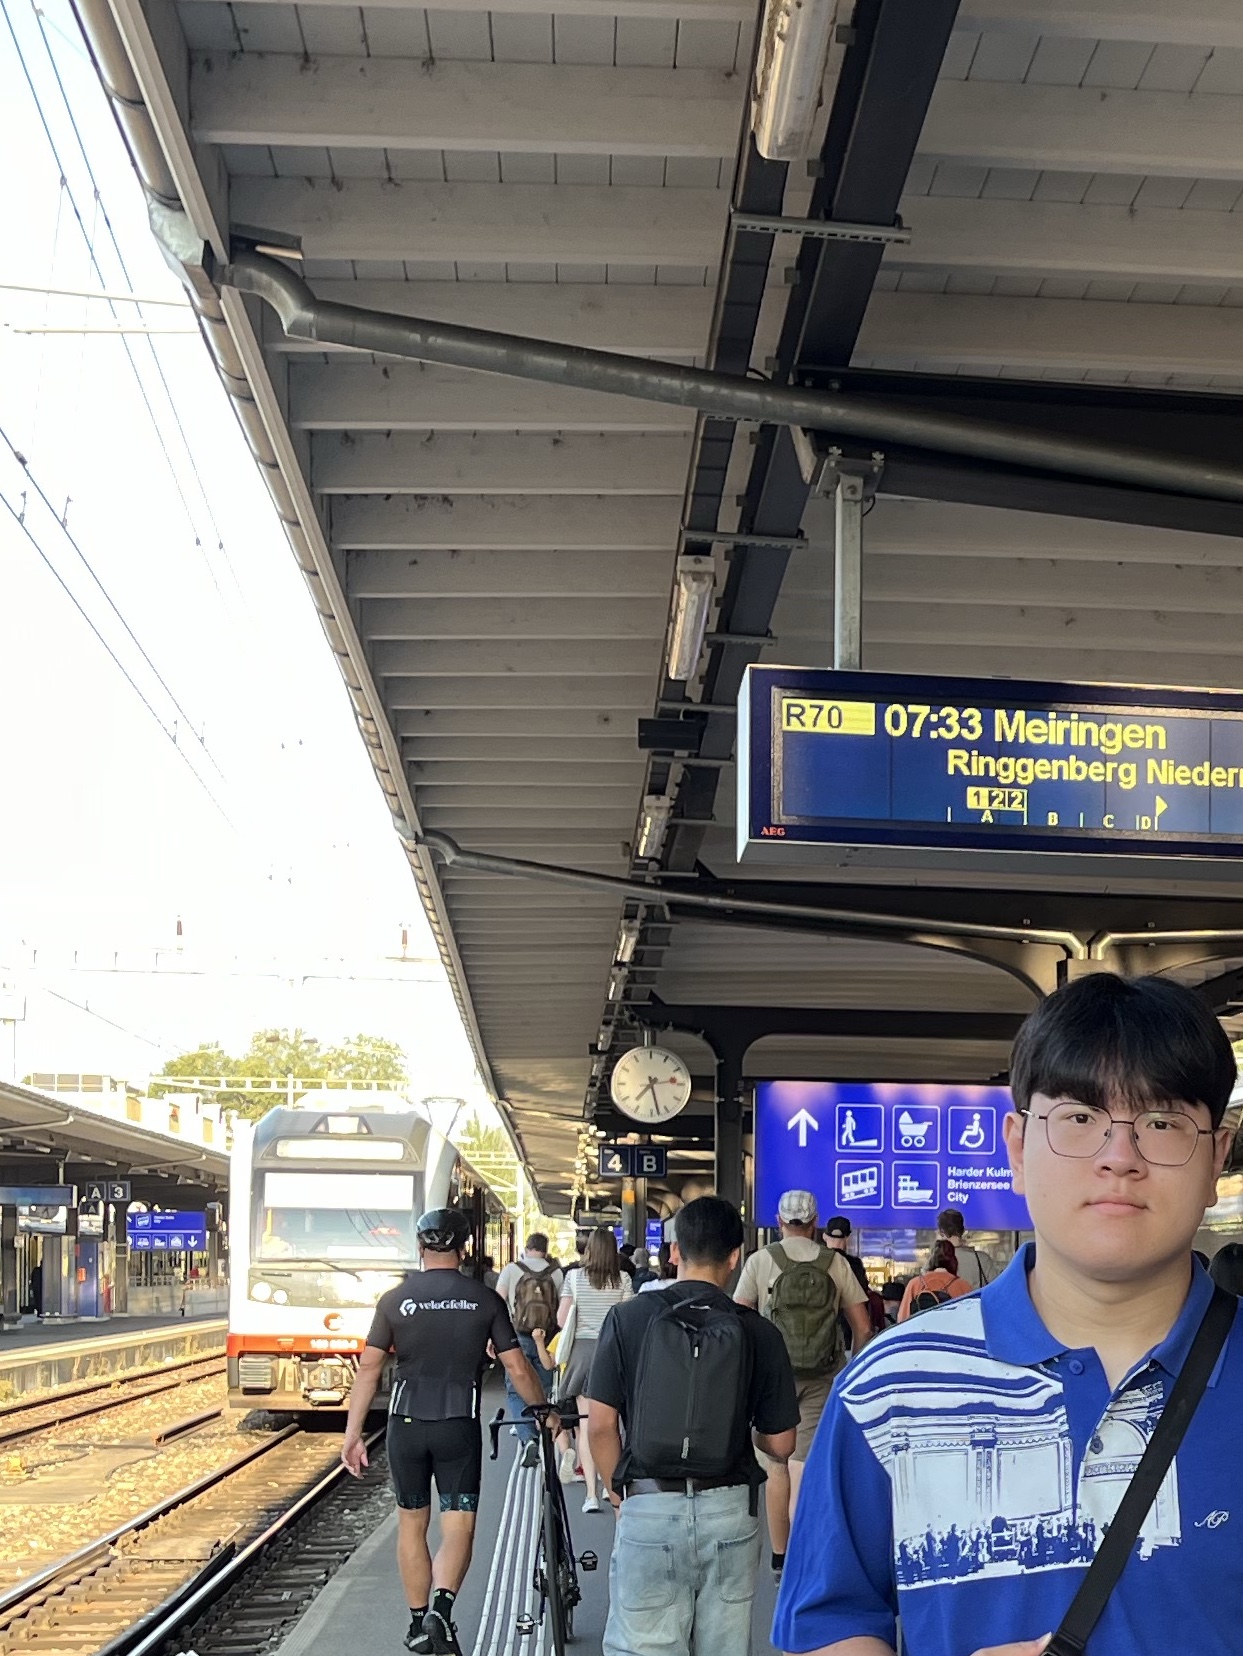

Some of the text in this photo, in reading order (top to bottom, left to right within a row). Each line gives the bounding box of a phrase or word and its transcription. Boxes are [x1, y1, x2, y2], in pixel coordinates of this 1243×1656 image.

[786, 703, 1167, 755] R70 07:33 Meiringen
[947, 748, 1137, 790] Ringgenberg
[980, 809, 994, 824] A
[1046, 811, 1059, 826] B
[1102, 814, 1115, 829] C
[760, 825, 786, 837] AEG
[607, 1153, 657, 1172] 4 B
[947, 1166, 984, 1177] Harder
[947, 1178, 1011, 1190] Brienzersee
[91, 1186, 124, 1199] A 3
[947, 1191, 969, 1205] City
